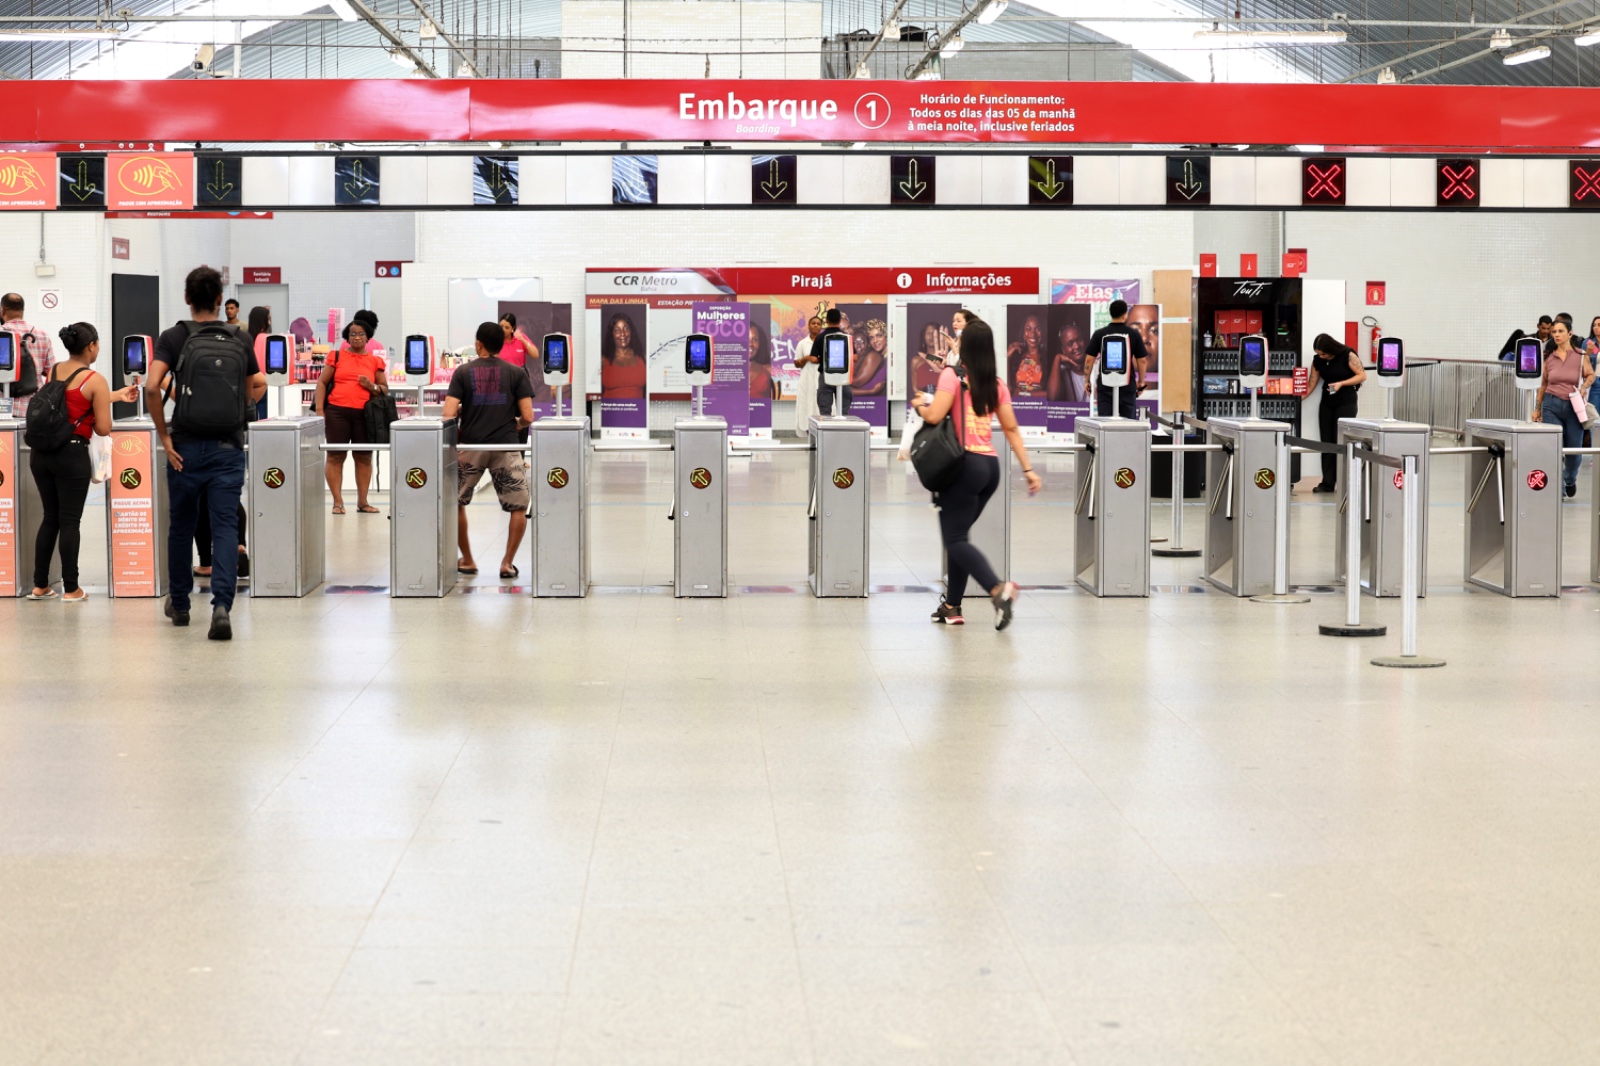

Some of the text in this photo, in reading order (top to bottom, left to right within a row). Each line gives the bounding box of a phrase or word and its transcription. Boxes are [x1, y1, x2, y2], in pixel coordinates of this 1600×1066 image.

[920, 93, 1065, 105] Horário de Funcionamento:
[679, 92, 838, 127] Embarque
[865, 100, 876, 121] 1
[910, 107, 1076, 118] Todos os dias das 05 da manhã
[736, 124, 780, 135] Boarding
[908, 120, 1074, 132] à meia noite, inclusive feriados
[614, 275, 678, 286] CCR Metrô
[791, 273, 833, 289] Pirajá
[927, 272, 1012, 289] Informações
[1076, 284, 1113, 299] Elas
[657, 299, 684, 307] ESTAÇÃO
[697, 311, 745, 320] Mulheres
[697, 320, 746, 337] FOCO
